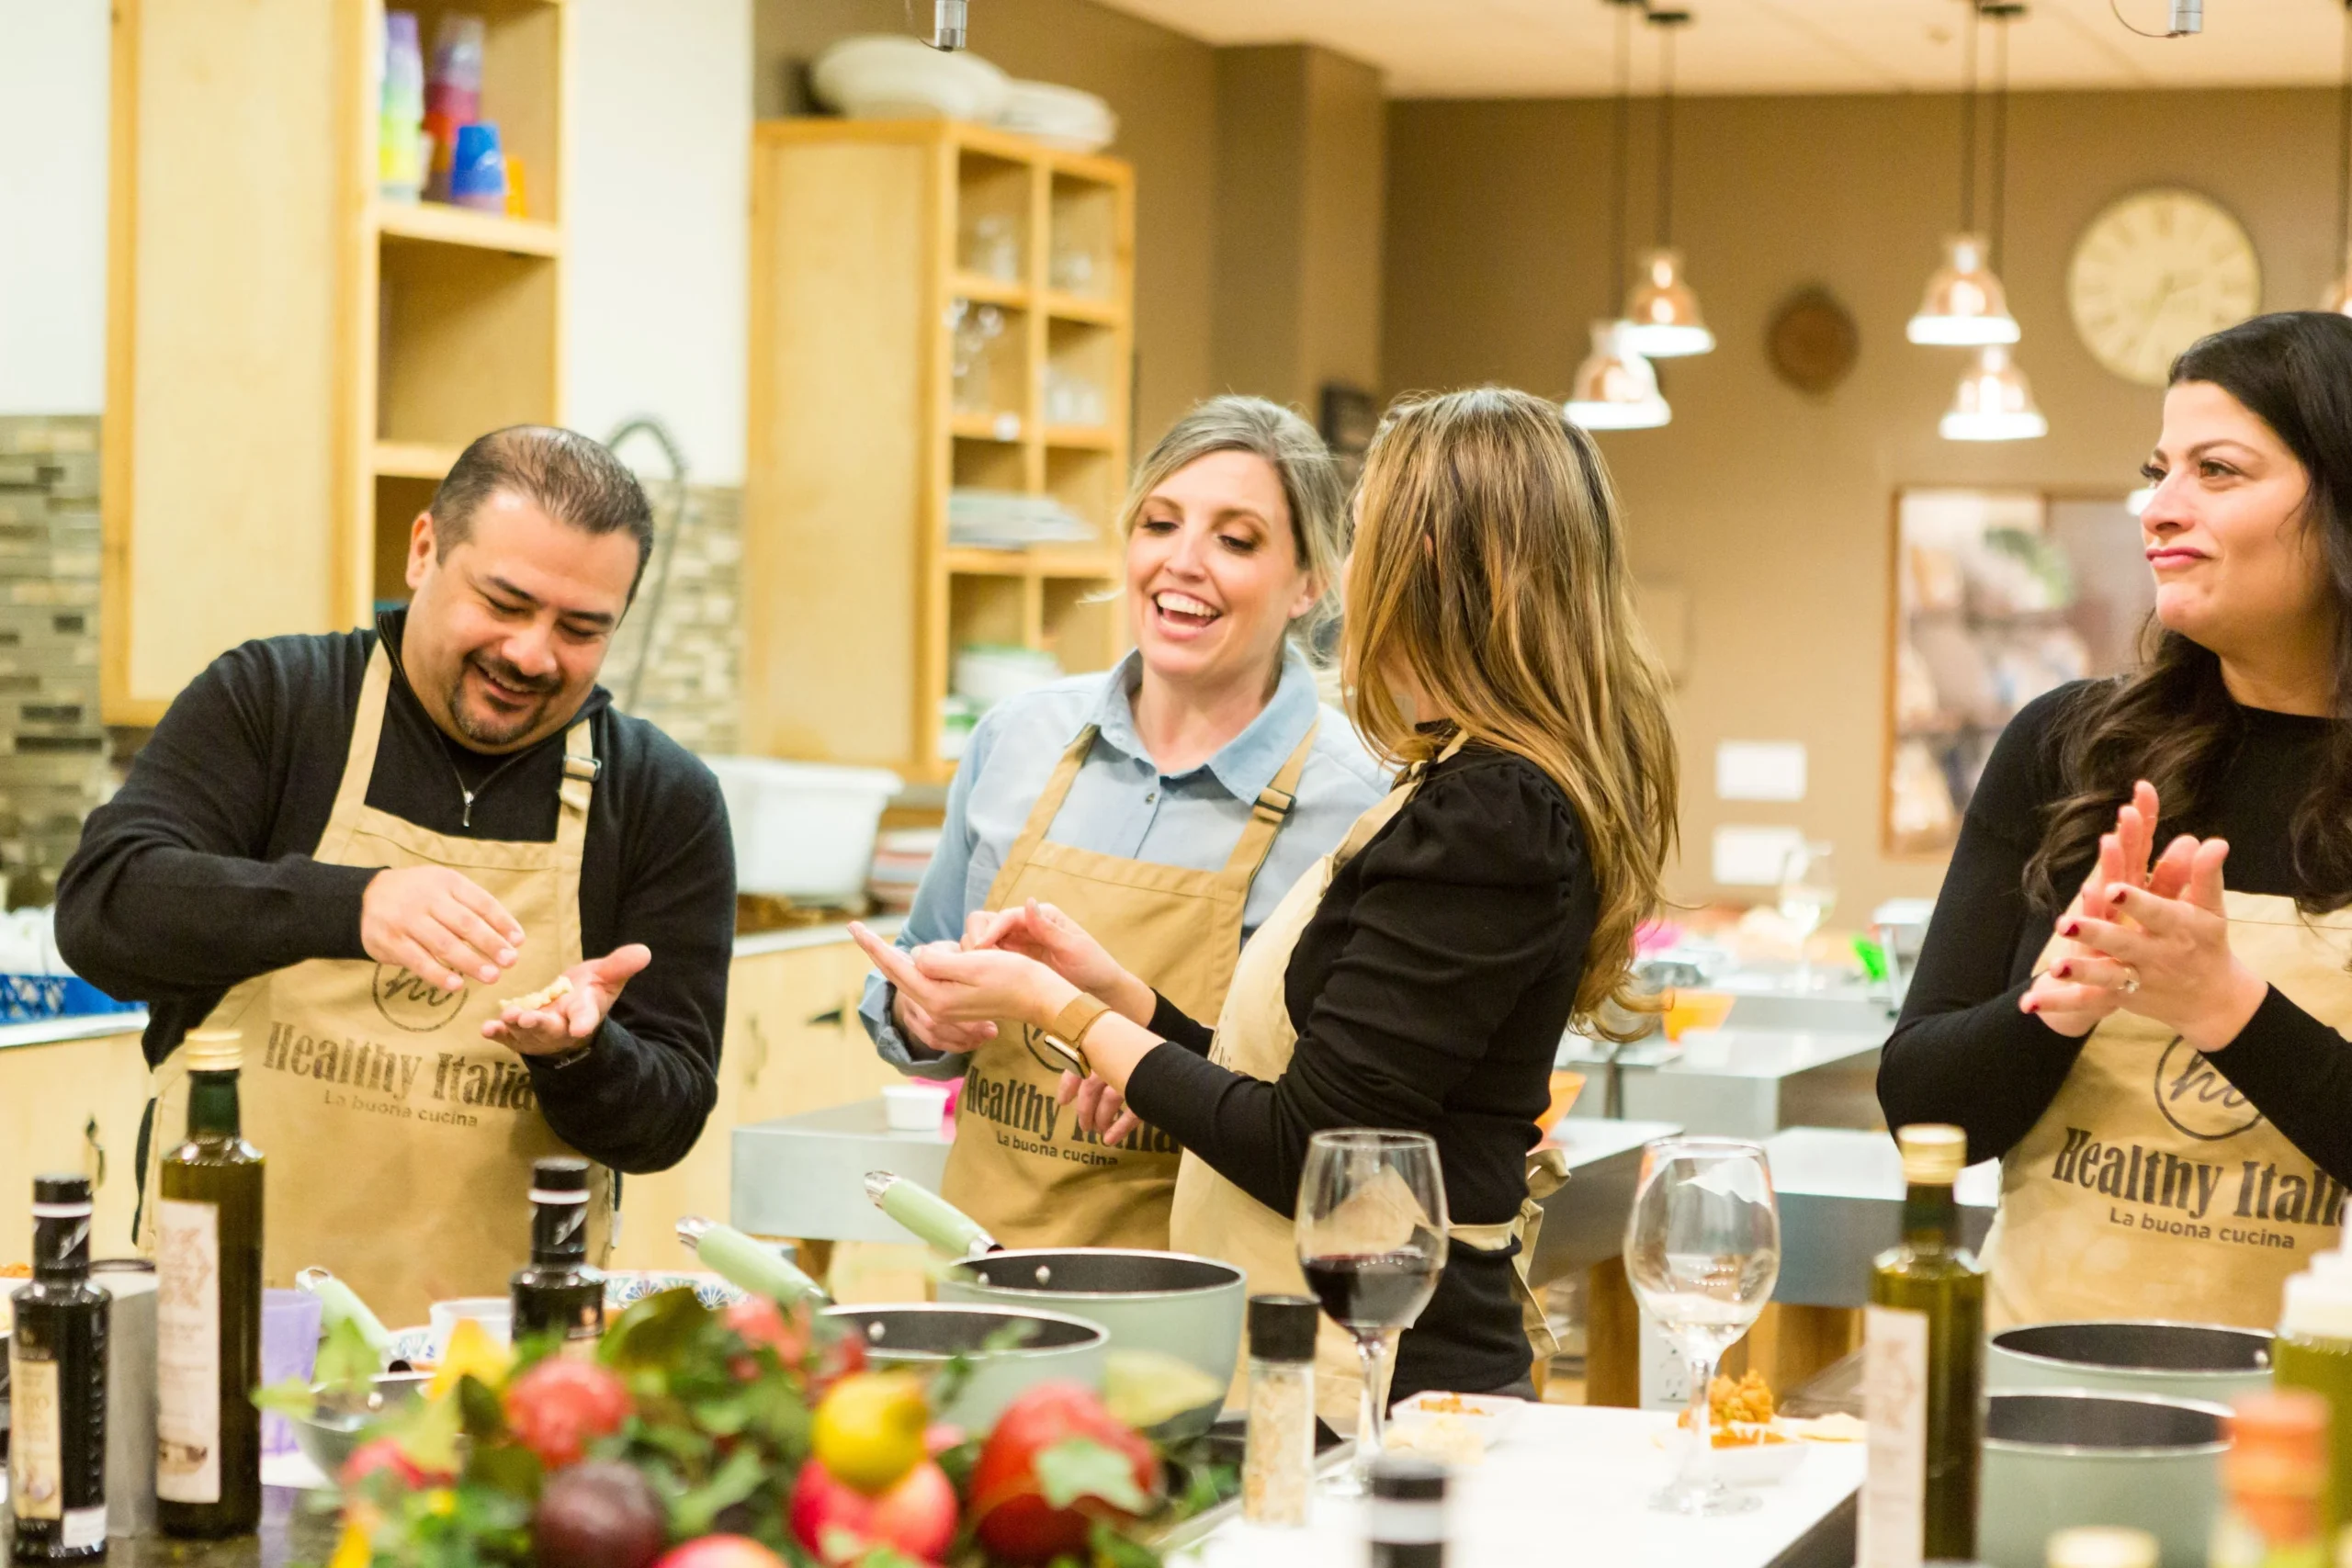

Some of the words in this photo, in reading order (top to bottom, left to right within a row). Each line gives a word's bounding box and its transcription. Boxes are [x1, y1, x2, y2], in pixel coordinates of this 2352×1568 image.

[263, 1021, 423, 1101] Healthy
[323, 1089, 346, 1106] La
[352, 1095, 413, 1119] buona
[418, 1108, 479, 1127] cucina
[967, 1065, 1061, 1142] Healthy
[997, 1130, 1010, 1147] La
[1012, 1134, 1058, 1157] buona
[1062, 1147, 1119, 1167] cucina
[2052, 1126, 2224, 1220] Healthy
[2233, 1160, 2346, 1227] Itali
[2109, 1206, 2135, 1227] La
[2141, 1213, 2212, 1240] buona
[2219, 1225, 2296, 1250] cucina
